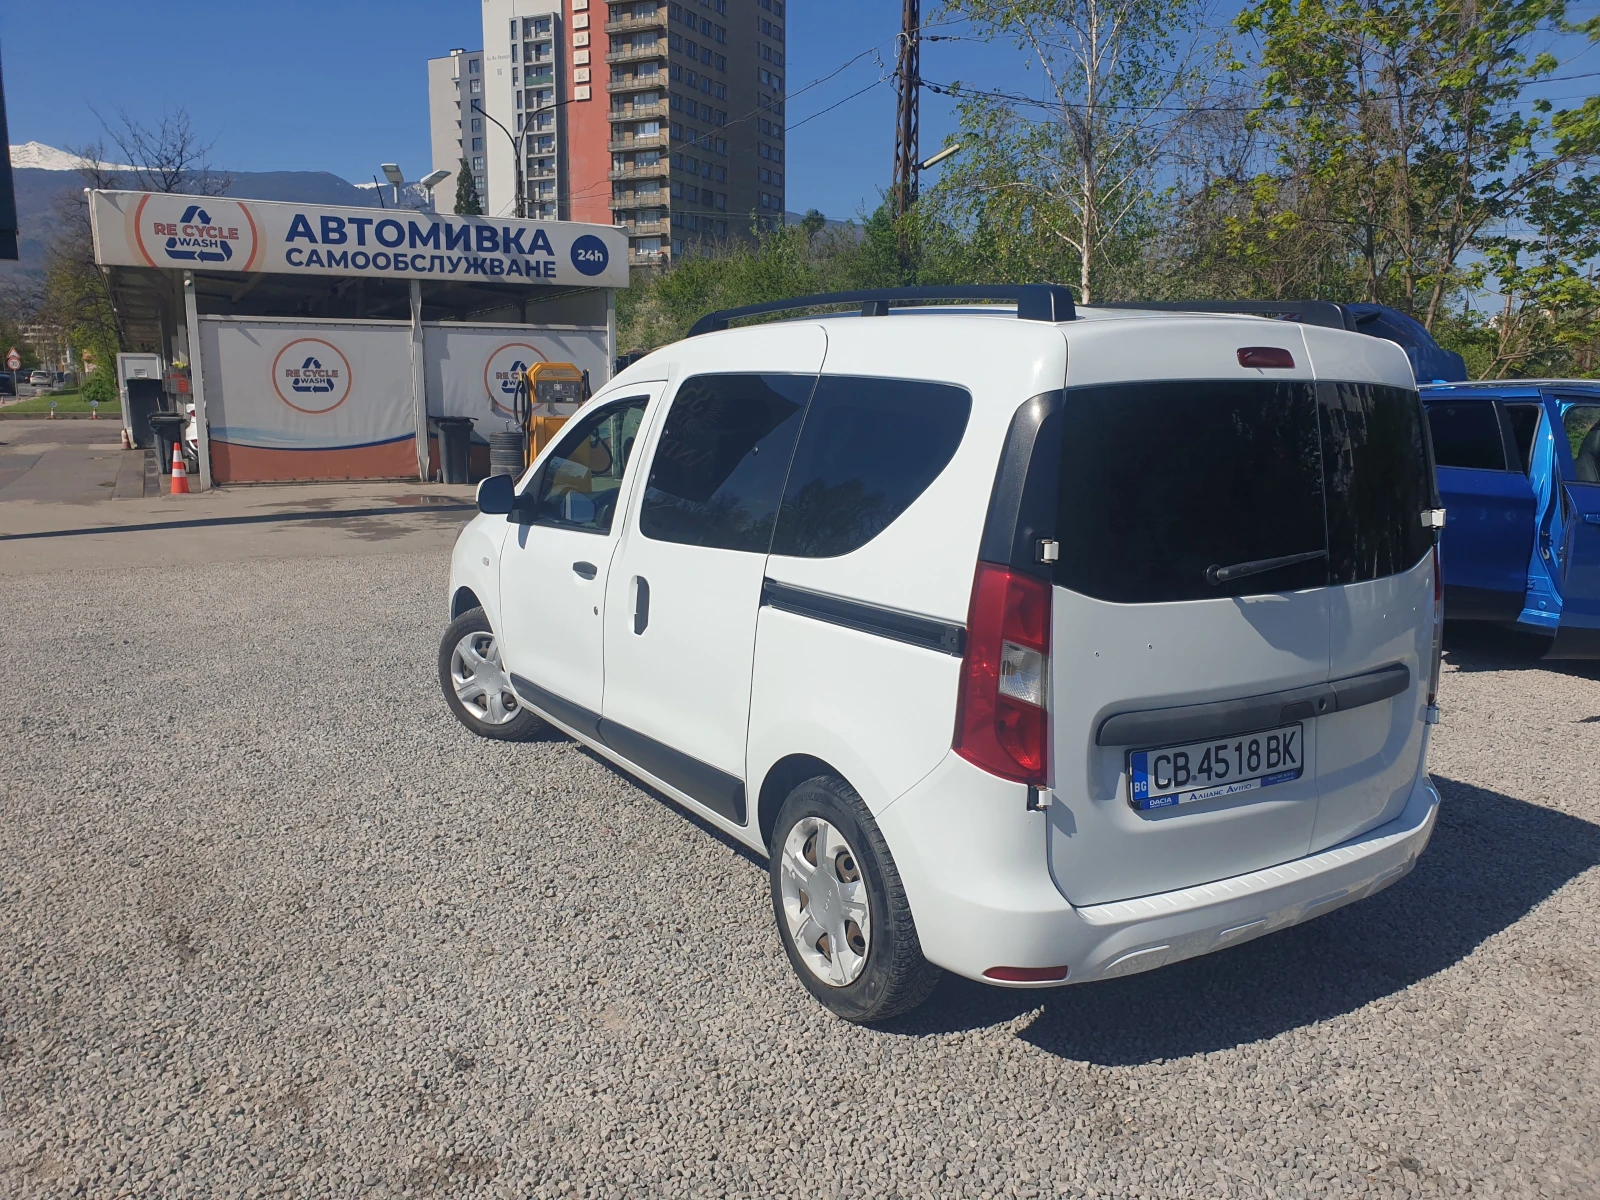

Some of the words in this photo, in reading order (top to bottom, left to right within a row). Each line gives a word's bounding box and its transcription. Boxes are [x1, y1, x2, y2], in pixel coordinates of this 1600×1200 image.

[153, 222, 178, 236] RE
[182, 224, 239, 240] CYCLE
[285, 213, 555, 257] АВТОМИВКА
[178, 237, 218, 248] WASH
[577, 249, 603, 262] 24h
[285, 247, 557, 279] САМООБСЛУЖВАНЕ
[286, 369, 301, 378] RE
[303, 369, 339, 378] CYCLE
[495, 371, 509, 380] RE
[1197, 738, 1261, 781] 4518
[1134, 780, 1147, 793] BG
[1149, 797, 1172, 806] DACIA
